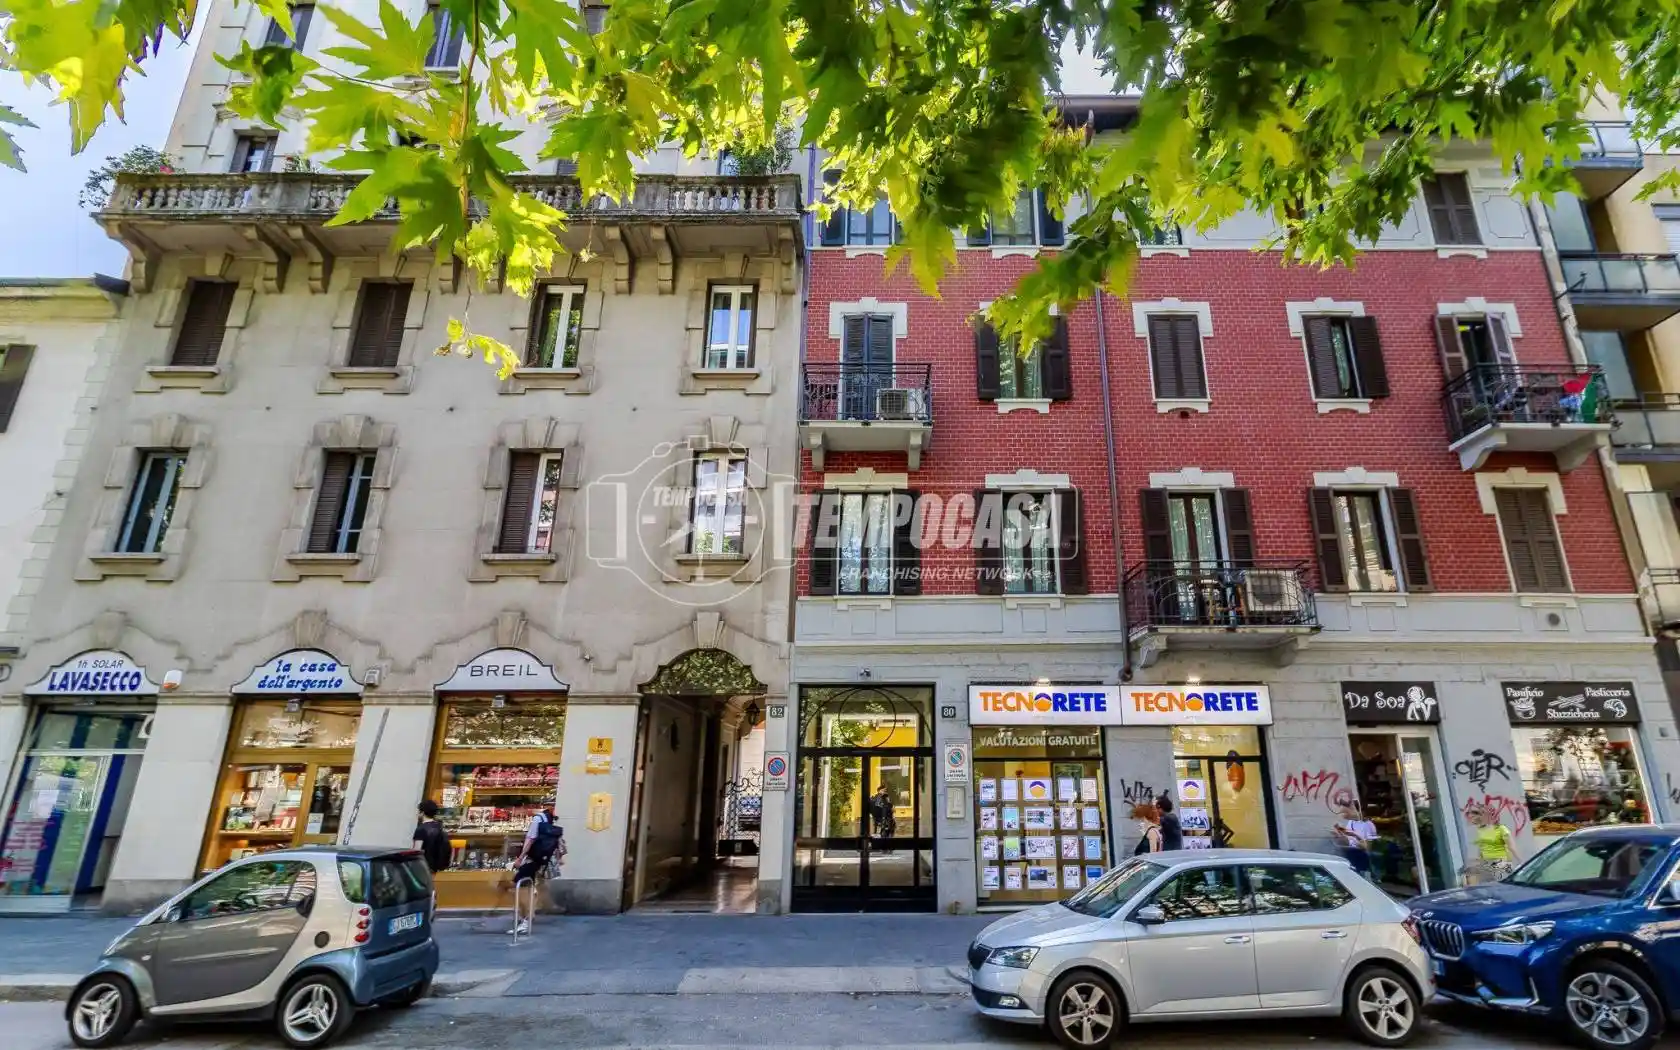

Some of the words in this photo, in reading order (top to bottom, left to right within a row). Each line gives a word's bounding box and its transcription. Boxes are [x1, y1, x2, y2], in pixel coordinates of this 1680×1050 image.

[92, 659, 124, 669] SOLAR
[276, 659, 292, 672] la
[300, 662, 336, 672] casa
[470, 664, 538, 677] BREIL
[48, 671, 141, 691] LAVASECCO
[257, 675, 342, 692] dell'argento
[1506, 686, 1544, 700] Panificio
[1585, 686, 1631, 697] Pasticceria
[979, 692, 1107, 712] TECNORETE
[1131, 692, 1259, 712] TECNORETE
[1344, 692, 1370, 709] Da
[1374, 690, 1406, 709] Soa
[771, 707, 783, 716] 82
[943, 708, 954, 717] 80
[1546, 708, 1600, 719] Stuzzicheria
[980, 735, 1046, 746] VALUTAZIONI
[1048, 735, 1097, 746] GRATUITE
